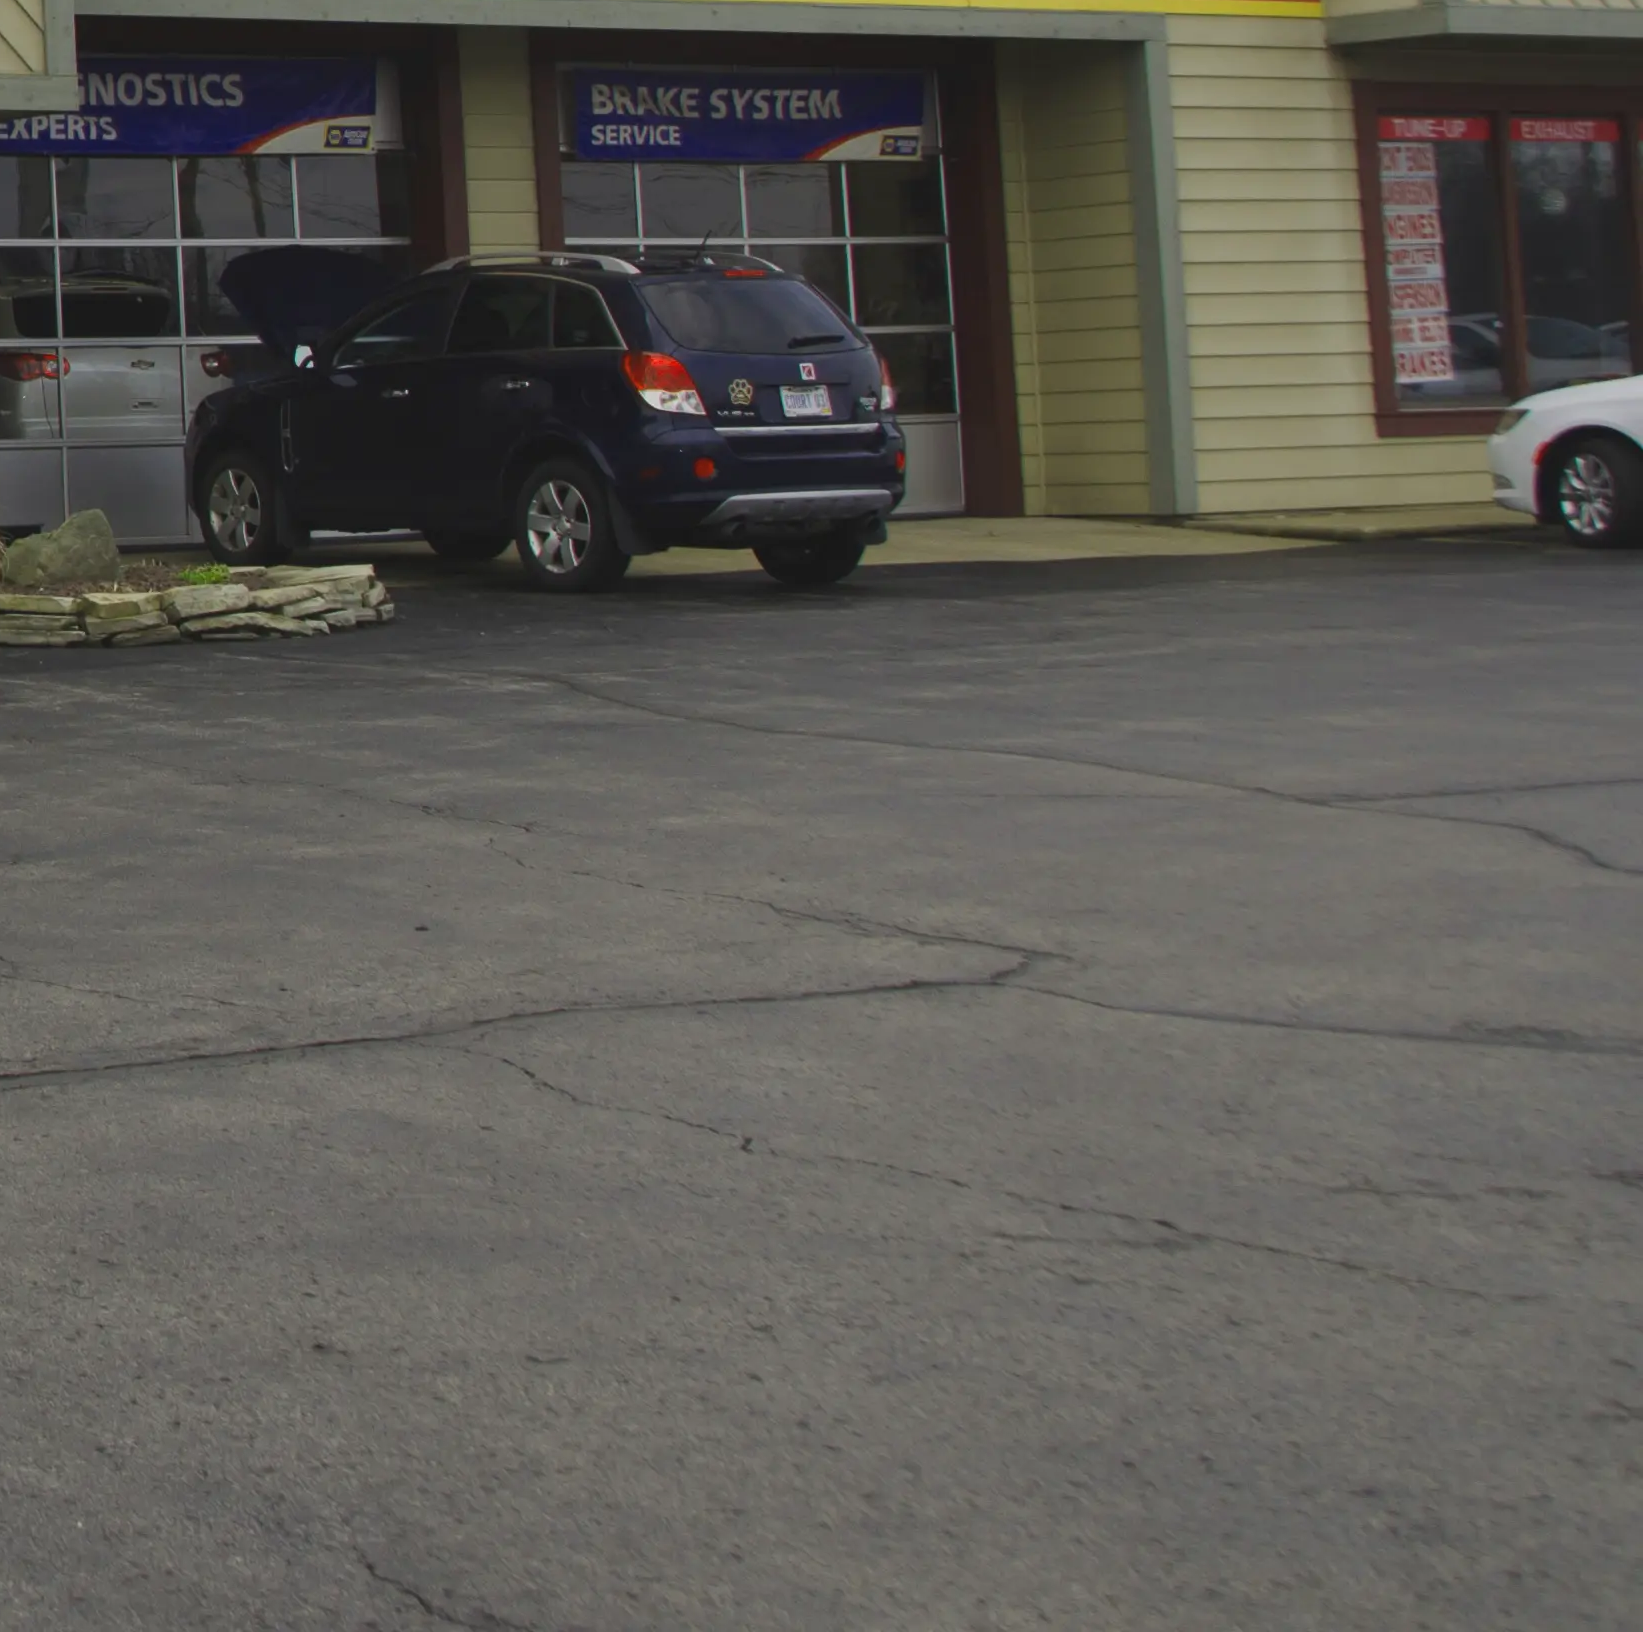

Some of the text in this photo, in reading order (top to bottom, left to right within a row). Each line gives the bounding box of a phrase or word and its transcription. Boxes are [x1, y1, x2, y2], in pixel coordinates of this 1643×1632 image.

[78, 73, 244, 108] NOSTICS
[591, 83, 843, 120] BRAKE SYSTEM
[591, 124, 682, 146] SERVICE
[1392, 119, 1467, 138] TUNE-UP
[1520, 120, 1596, 139] EXHAUST
[1397, 350, 1450, 379] RAKES
